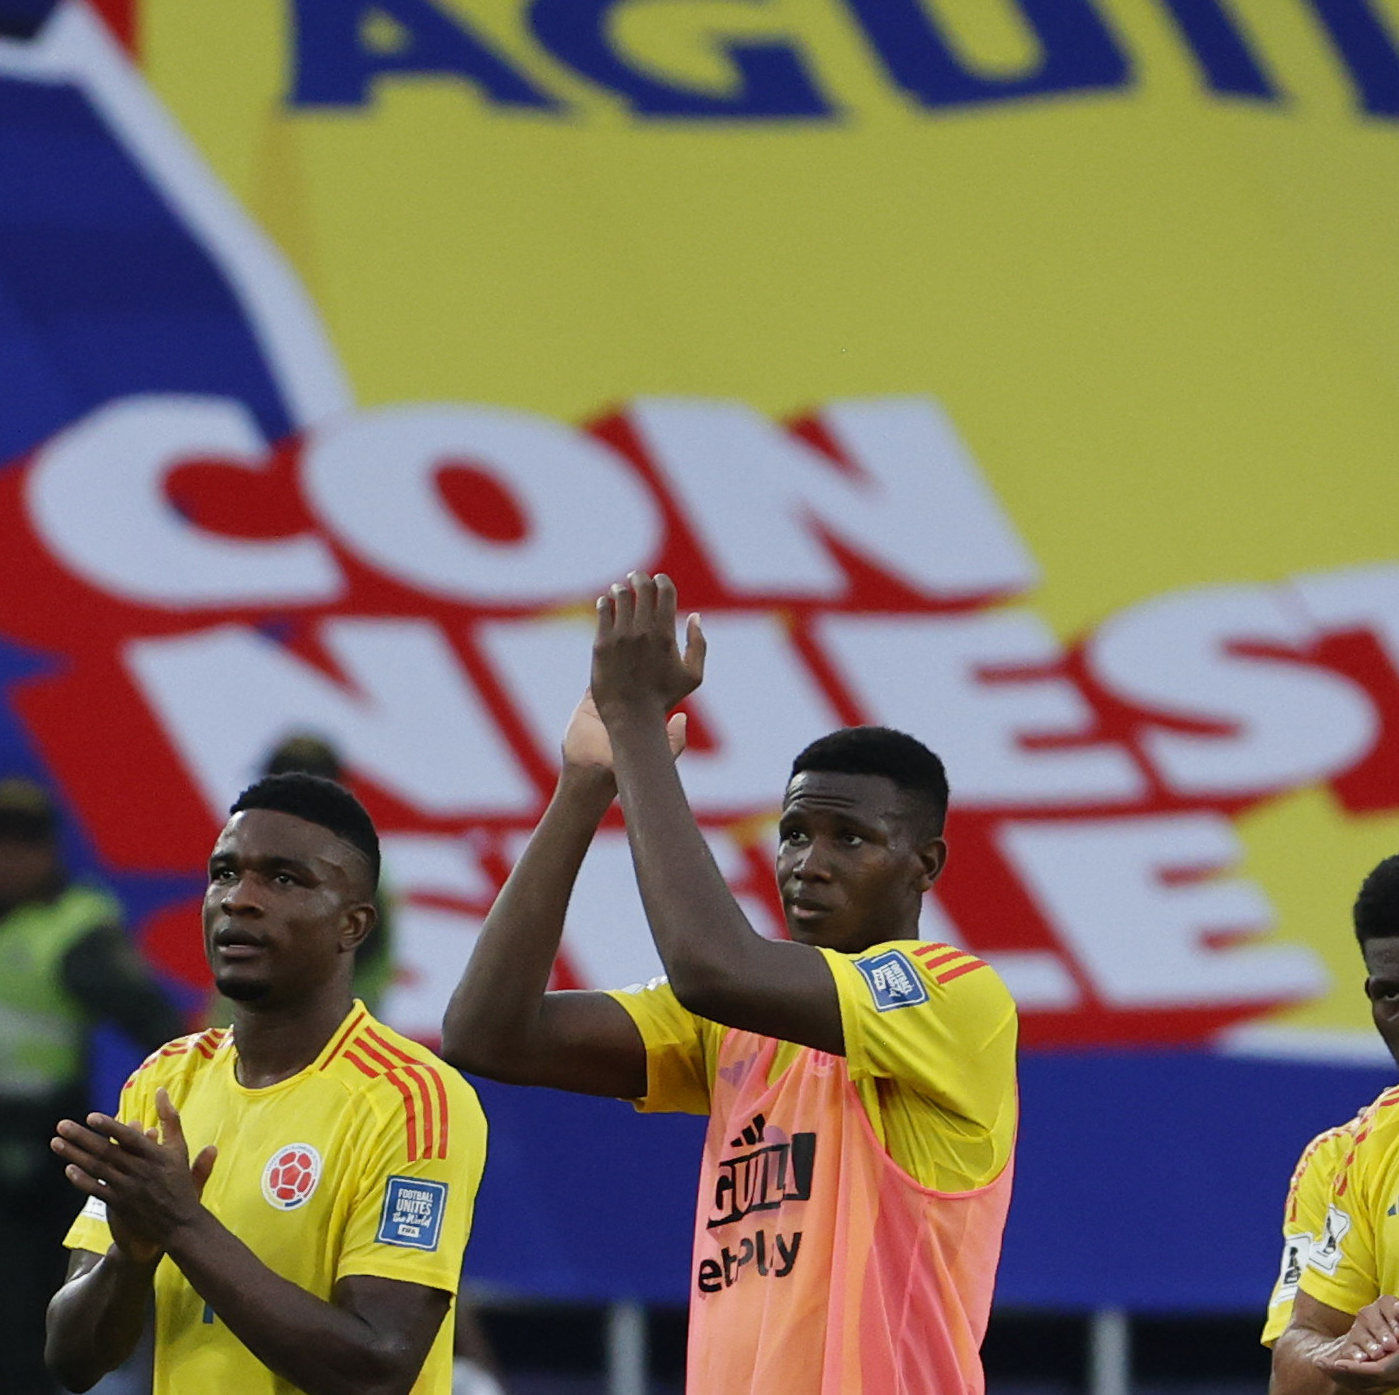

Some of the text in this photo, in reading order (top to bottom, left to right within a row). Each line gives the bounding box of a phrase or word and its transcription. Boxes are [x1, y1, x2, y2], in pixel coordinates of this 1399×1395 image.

[26, 393, 1042, 606] CON
[398, 1188, 434, 1202] FOOTBALL
[395, 1199, 433, 1216] UNITES
